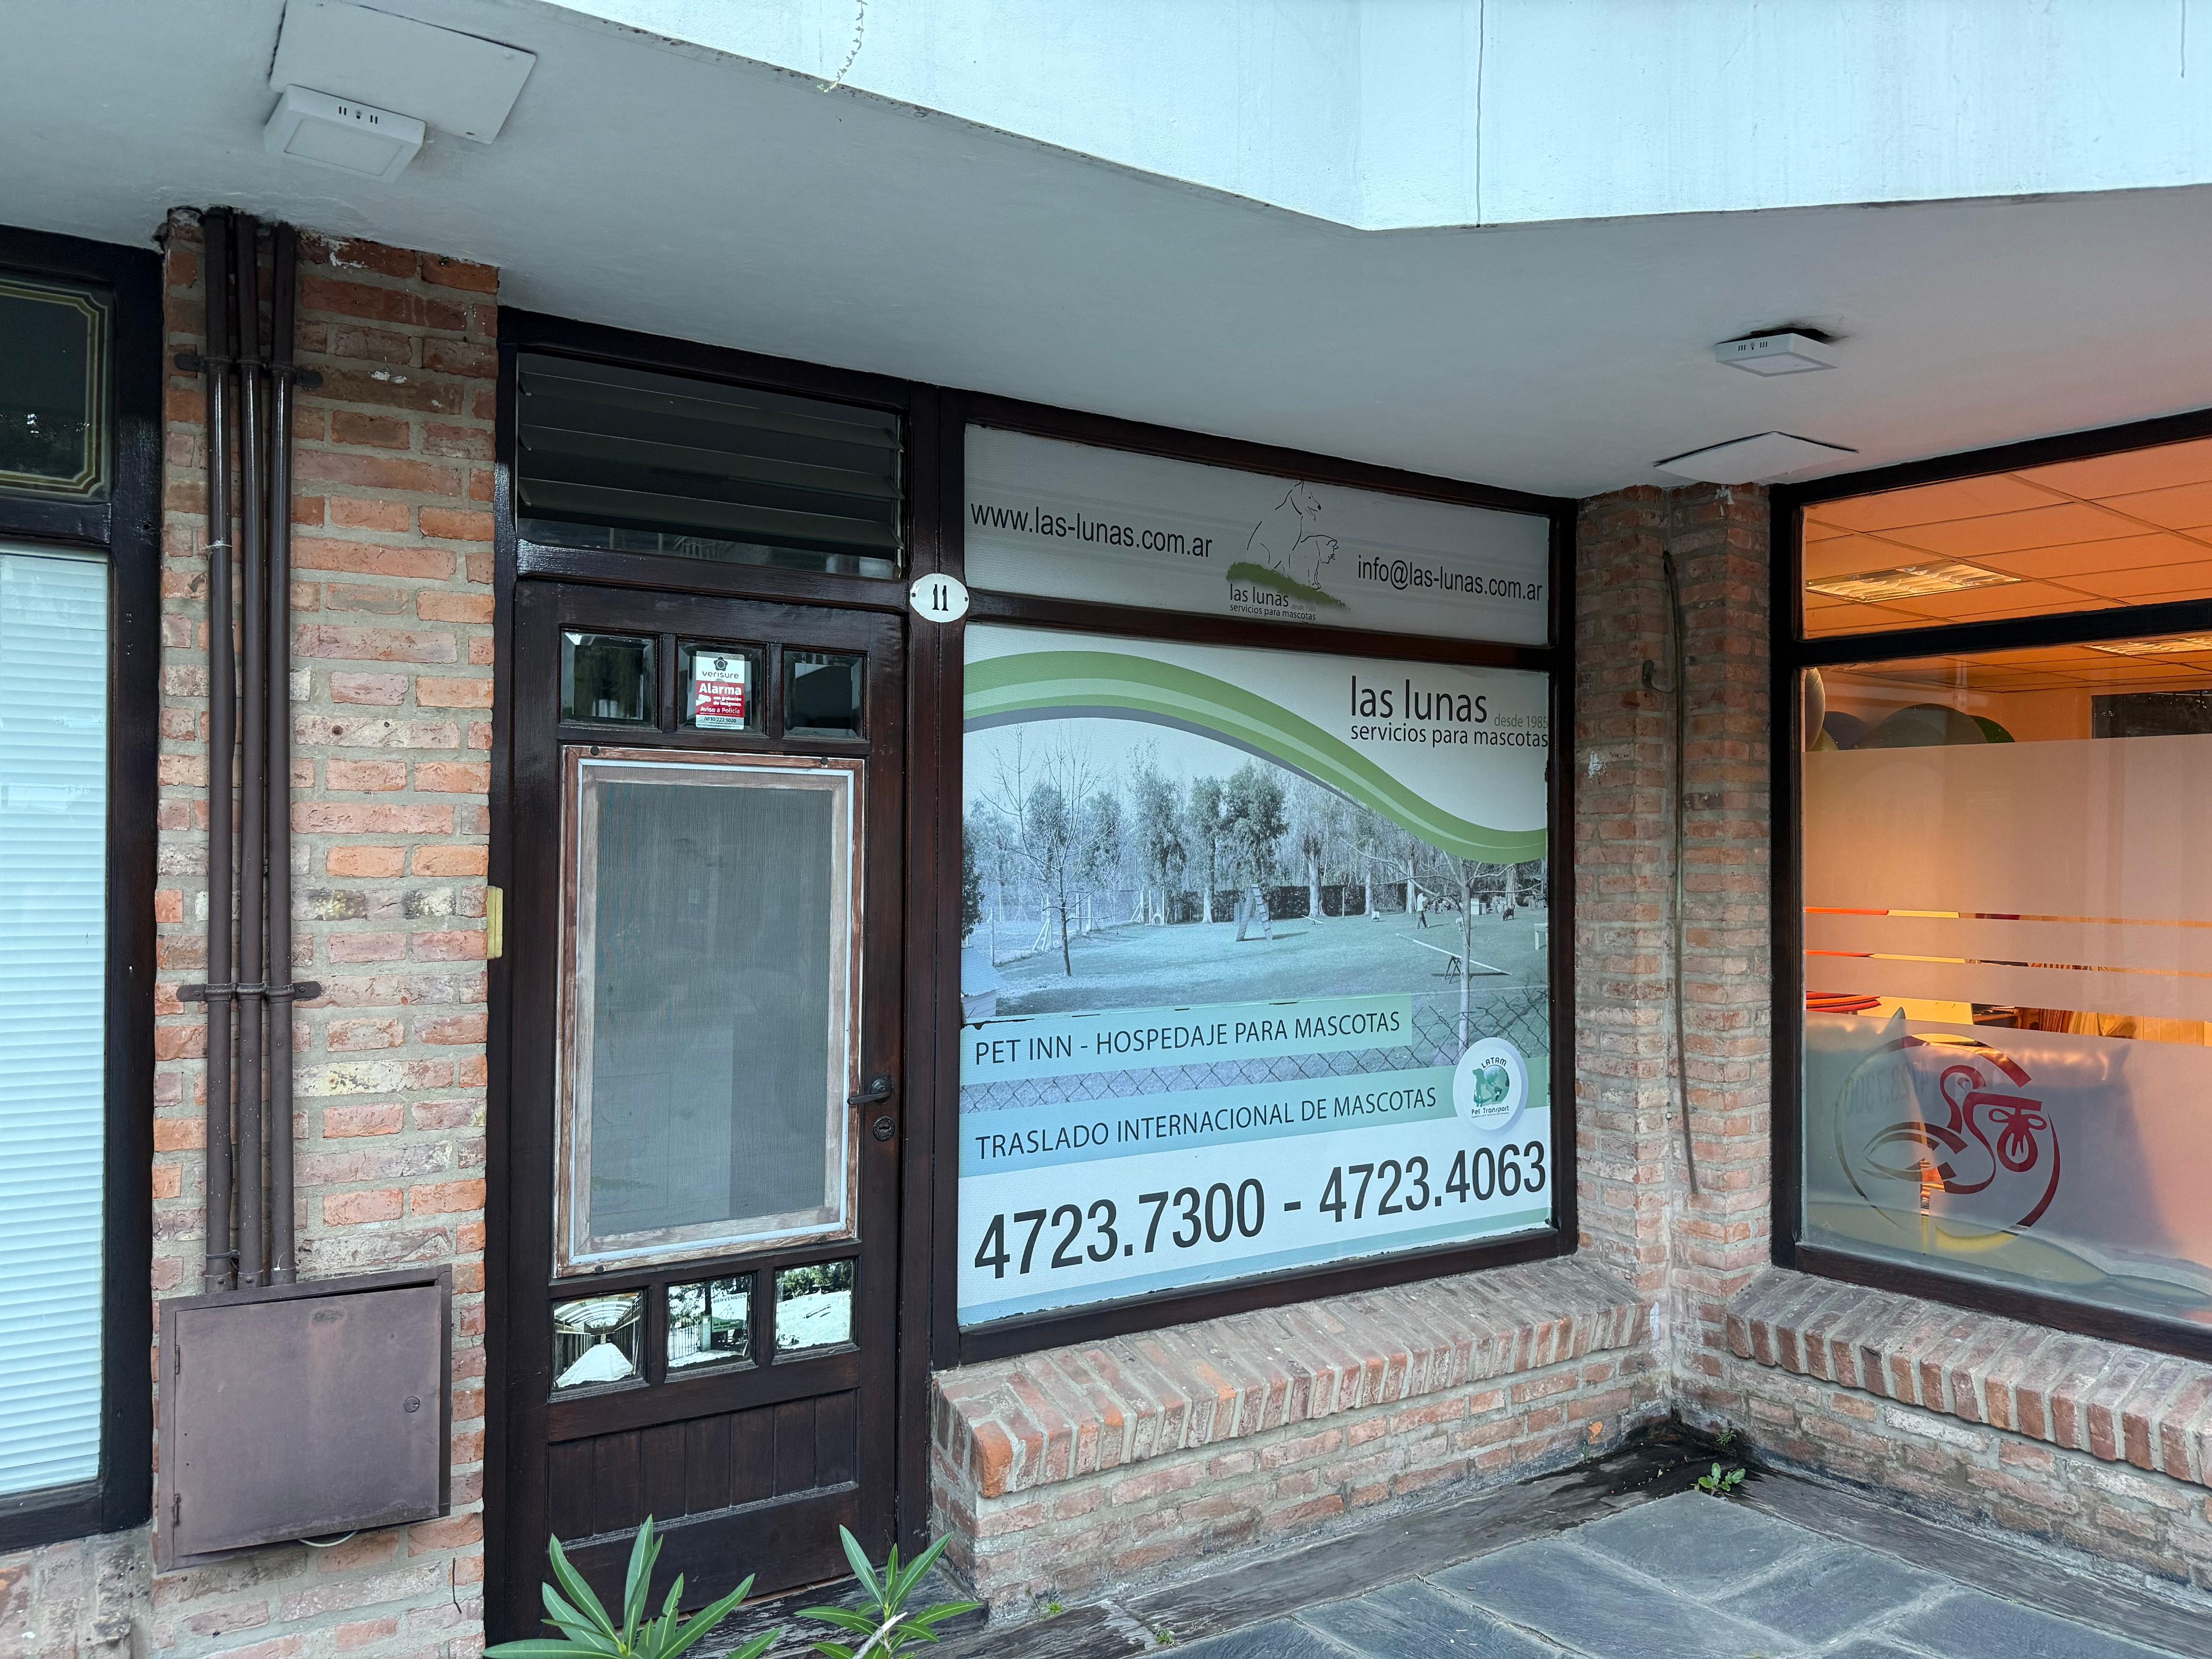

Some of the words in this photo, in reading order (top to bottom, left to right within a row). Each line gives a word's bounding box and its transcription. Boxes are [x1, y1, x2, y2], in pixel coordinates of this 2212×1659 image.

[970, 503, 1212, 558] www.las-lunas.com.ar
[1358, 555, 1543, 601] info@las-lunas.com.ar
[932, 584, 949, 611] 11
[1230, 583, 1248, 602] las
[1253, 586, 1289, 607] lunas
[1230, 604, 1262, 615] servicios
[1264, 608, 1280, 617] para
[1283, 611, 1316, 621] mascotas
[699, 683, 742, 695] Alarma
[1351, 675, 1393, 718] las
[1405, 679, 1487, 723] lunas
[1494, 713, 1523, 727] desde
[1526, 715, 1548, 728] 1985
[1351, 722, 1426, 743] servicios
[1432, 728, 1468, 748] para
[1474, 730, 1548, 748] mascotas
[976, 1040, 1021, 1065] PET
[1029, 1035, 1071, 1060] INN
[1097, 1024, 1227, 1055] HOSPEDAJE
[1235, 1020, 1288, 1044] PARA
[1295, 1011, 1400, 1038] MASCOTAS
[1481, 1057, 1507, 1069] LATAM
[1483, 1105, 1509, 1114] Transport
[976, 1122, 1109, 1160] TRASLADO
[1118, 1103, 1294, 1143] INTERNACIONAL
[1301, 1099, 1327, 1121] DE
[1334, 1087, 1436, 1118] MASCOTAS
[975, 1178, 1265, 1279] 4723.7300
[1319, 1141, 1546, 1223] 4723.4063
[713, 1294, 746, 1304] BIENVENIDOS
